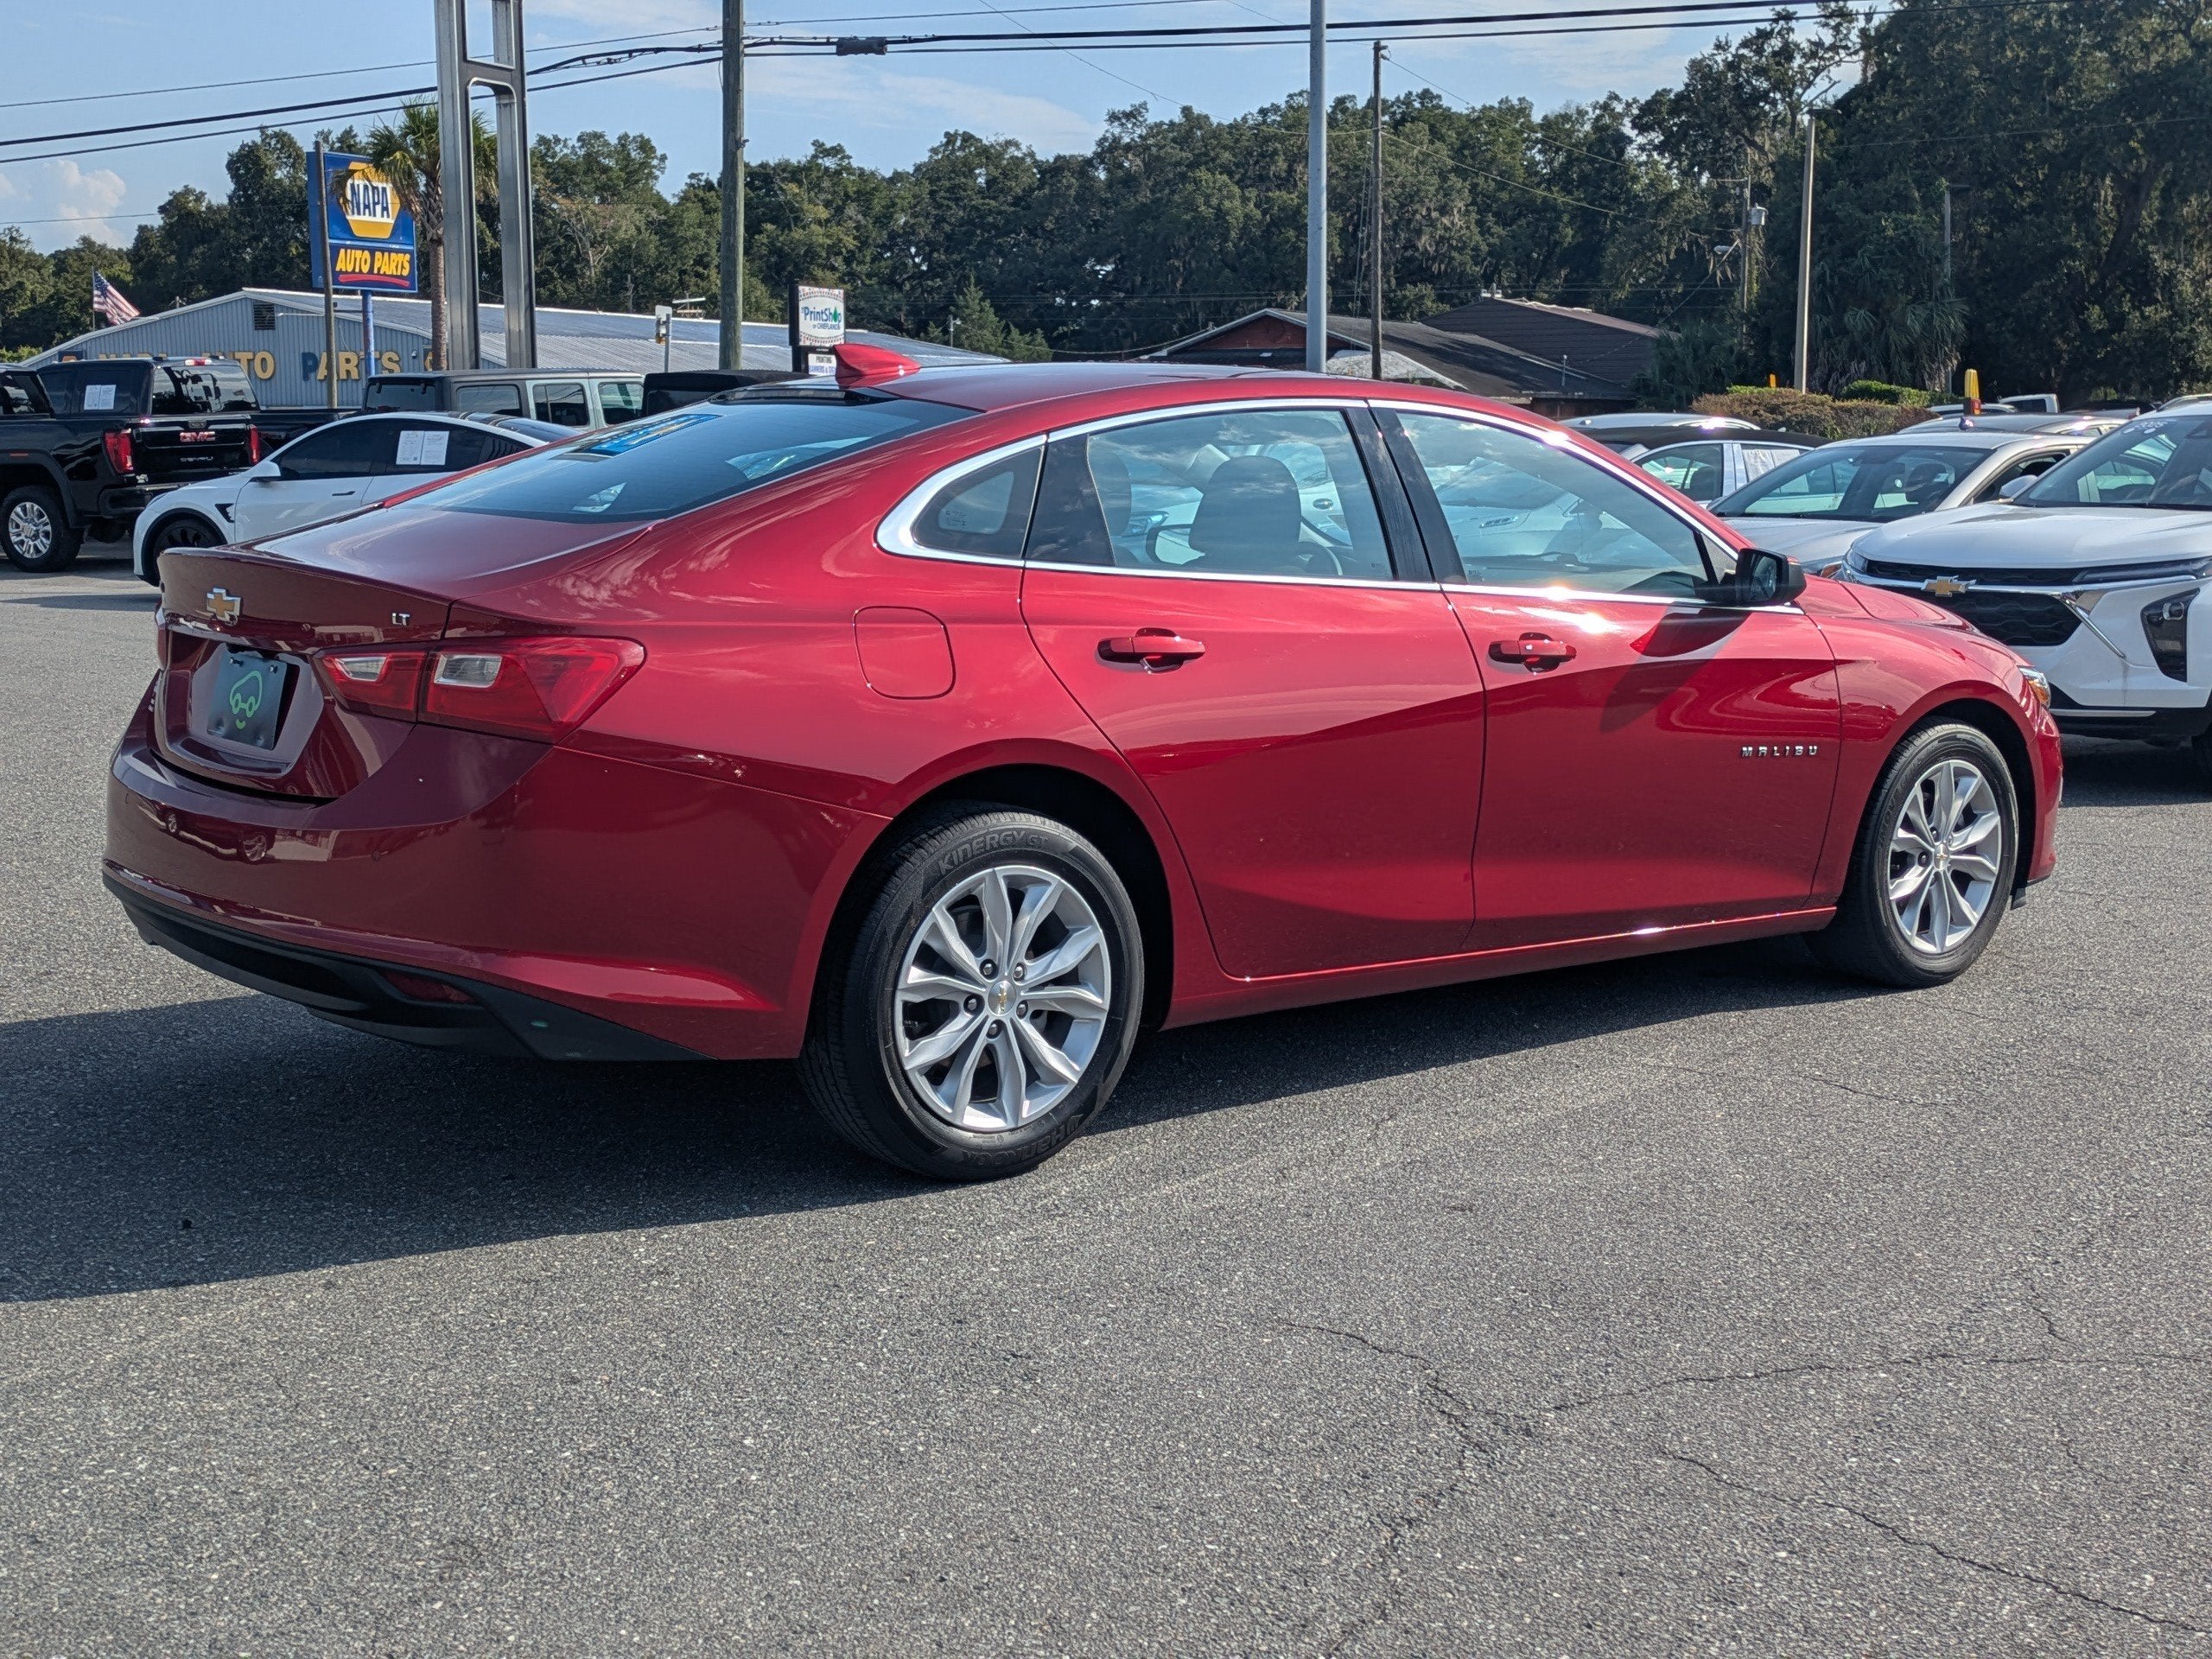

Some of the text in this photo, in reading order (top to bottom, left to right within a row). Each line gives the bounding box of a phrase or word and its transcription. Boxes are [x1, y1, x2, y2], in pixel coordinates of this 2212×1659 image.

[350, 182, 391, 219] NAPA
[335, 248, 410, 276] AUTO PARTS
[179, 431, 215, 442] GMC
[391, 613, 410, 626] LT
[1741, 746, 1818, 757] MALIBU
[938, 830, 1026, 875] KINERGY
